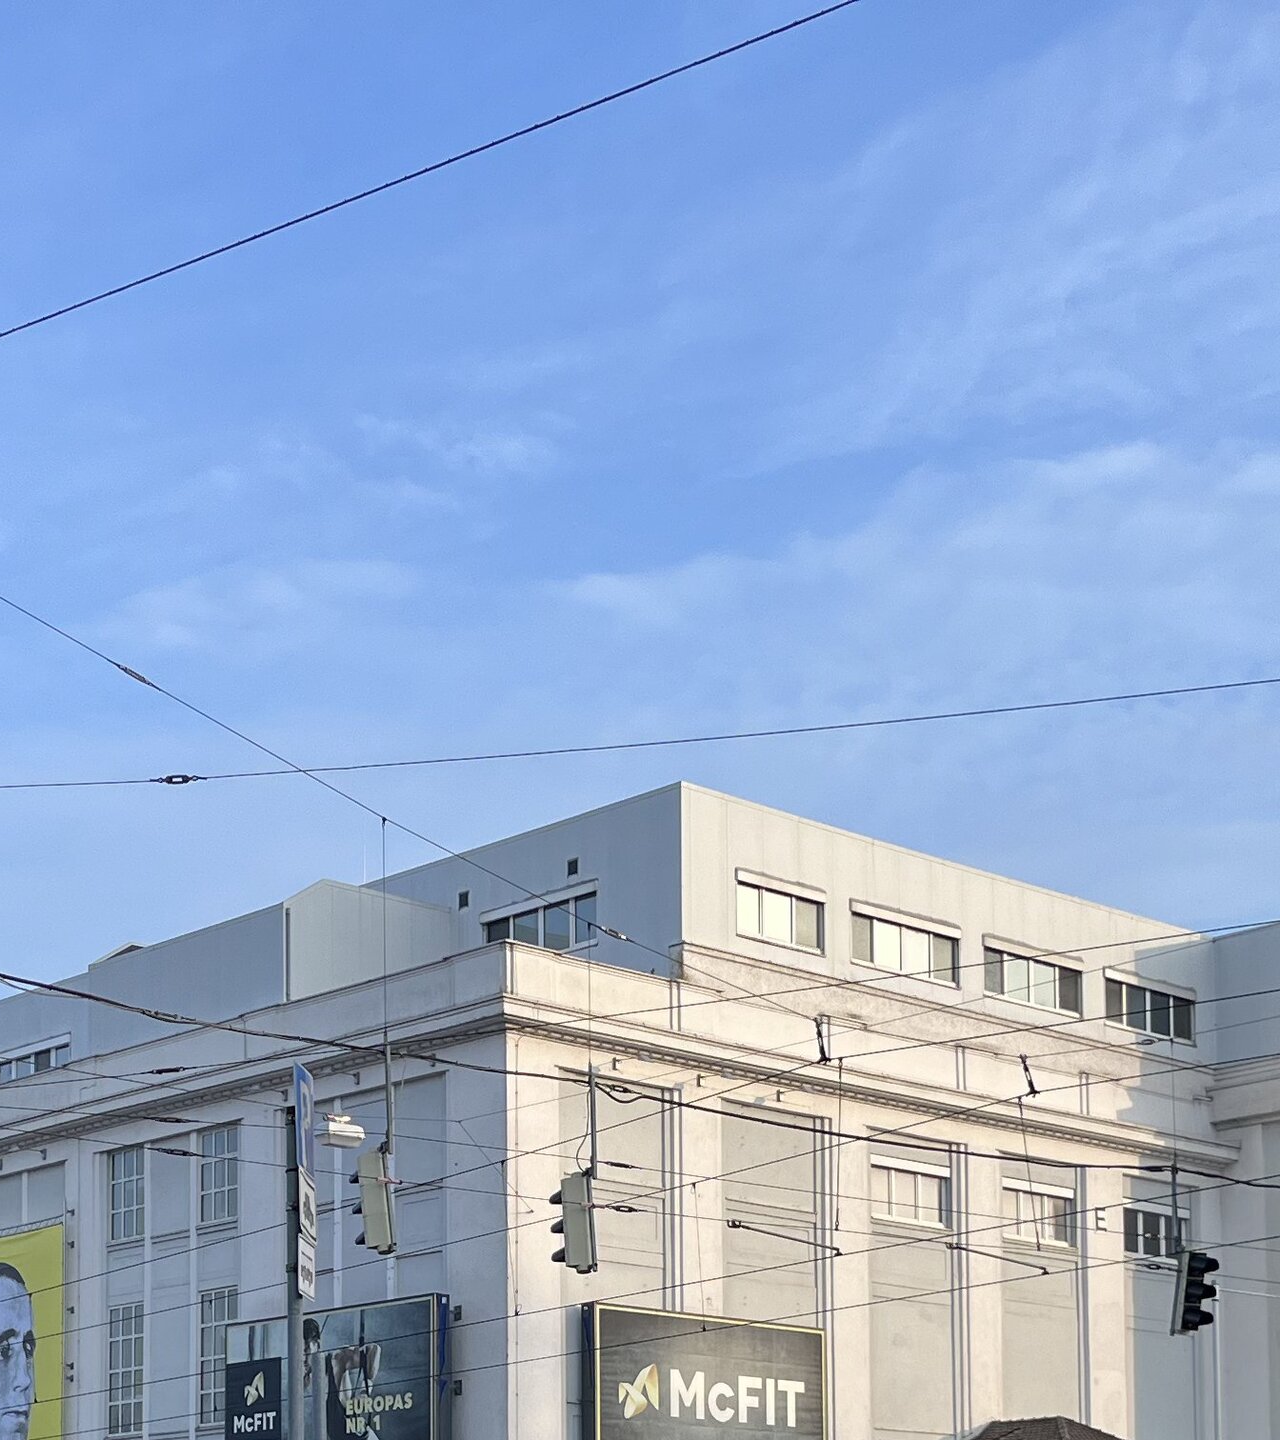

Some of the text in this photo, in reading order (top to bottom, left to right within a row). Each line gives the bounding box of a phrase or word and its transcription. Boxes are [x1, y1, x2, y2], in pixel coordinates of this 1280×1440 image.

[346, 1392, 413, 1416] EUROPAS
[669, 1367, 806, 1428] McFIT
[233, 1411, 277, 1434] McFIT
[373, 1415, 381, 1431] 1
